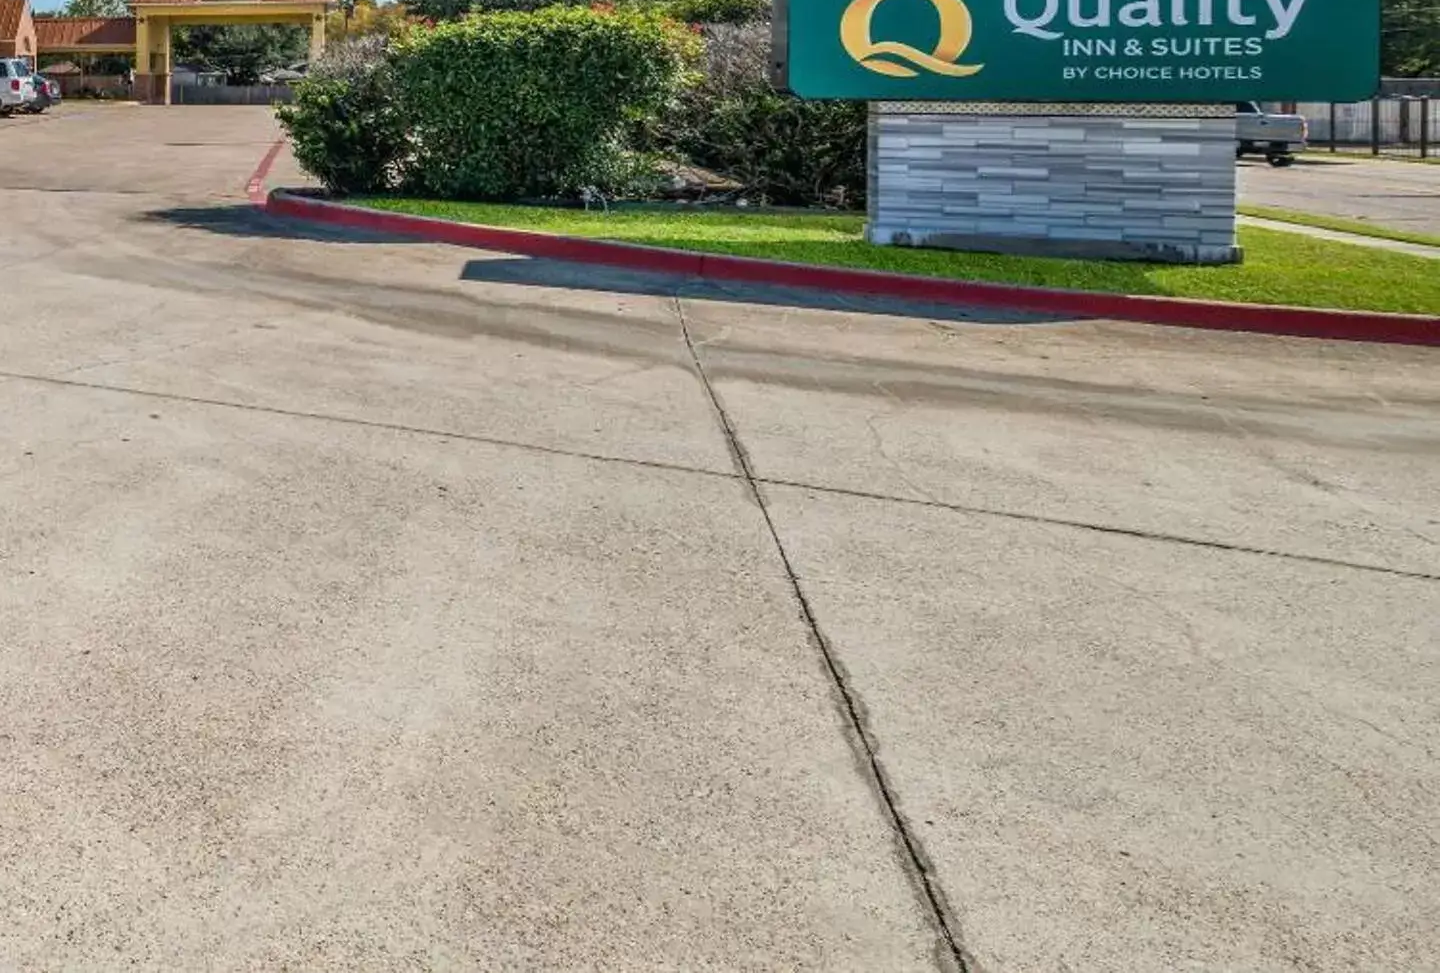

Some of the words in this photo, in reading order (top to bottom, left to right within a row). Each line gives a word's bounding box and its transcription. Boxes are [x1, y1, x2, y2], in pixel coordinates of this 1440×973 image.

[1063, 39, 1116, 56] INN
[1123, 38, 1143, 56] &
[1151, 37, 1262, 56] SUITES
[1063, 67, 1087, 80] BY
[1095, 66, 1172, 79] CHOICE
[1179, 66, 1262, 79] HOTELS
